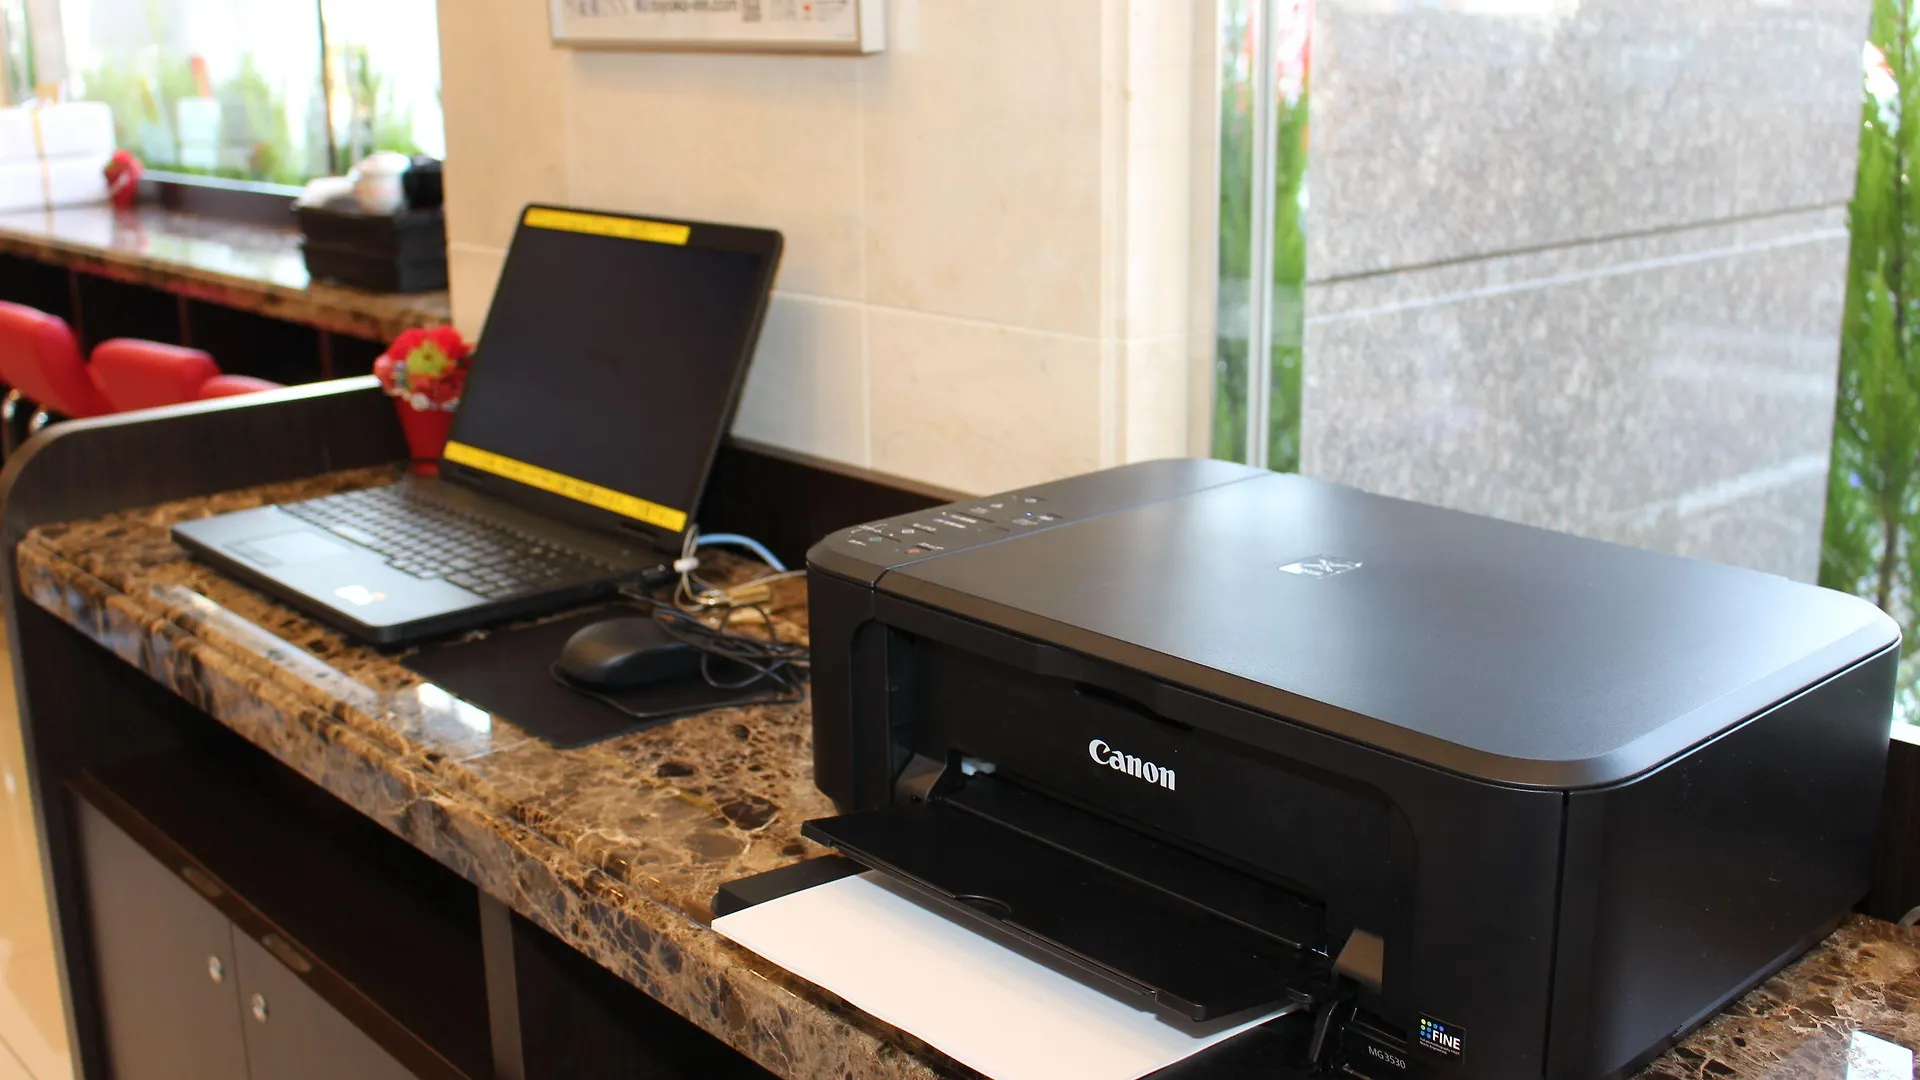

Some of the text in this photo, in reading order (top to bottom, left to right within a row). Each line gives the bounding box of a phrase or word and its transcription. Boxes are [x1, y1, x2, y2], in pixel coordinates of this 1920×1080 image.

[1088, 739, 1176, 791] Canon
[1432, 1029, 1461, 1050] FINE
[1368, 1045, 1406, 1069] MG3530
